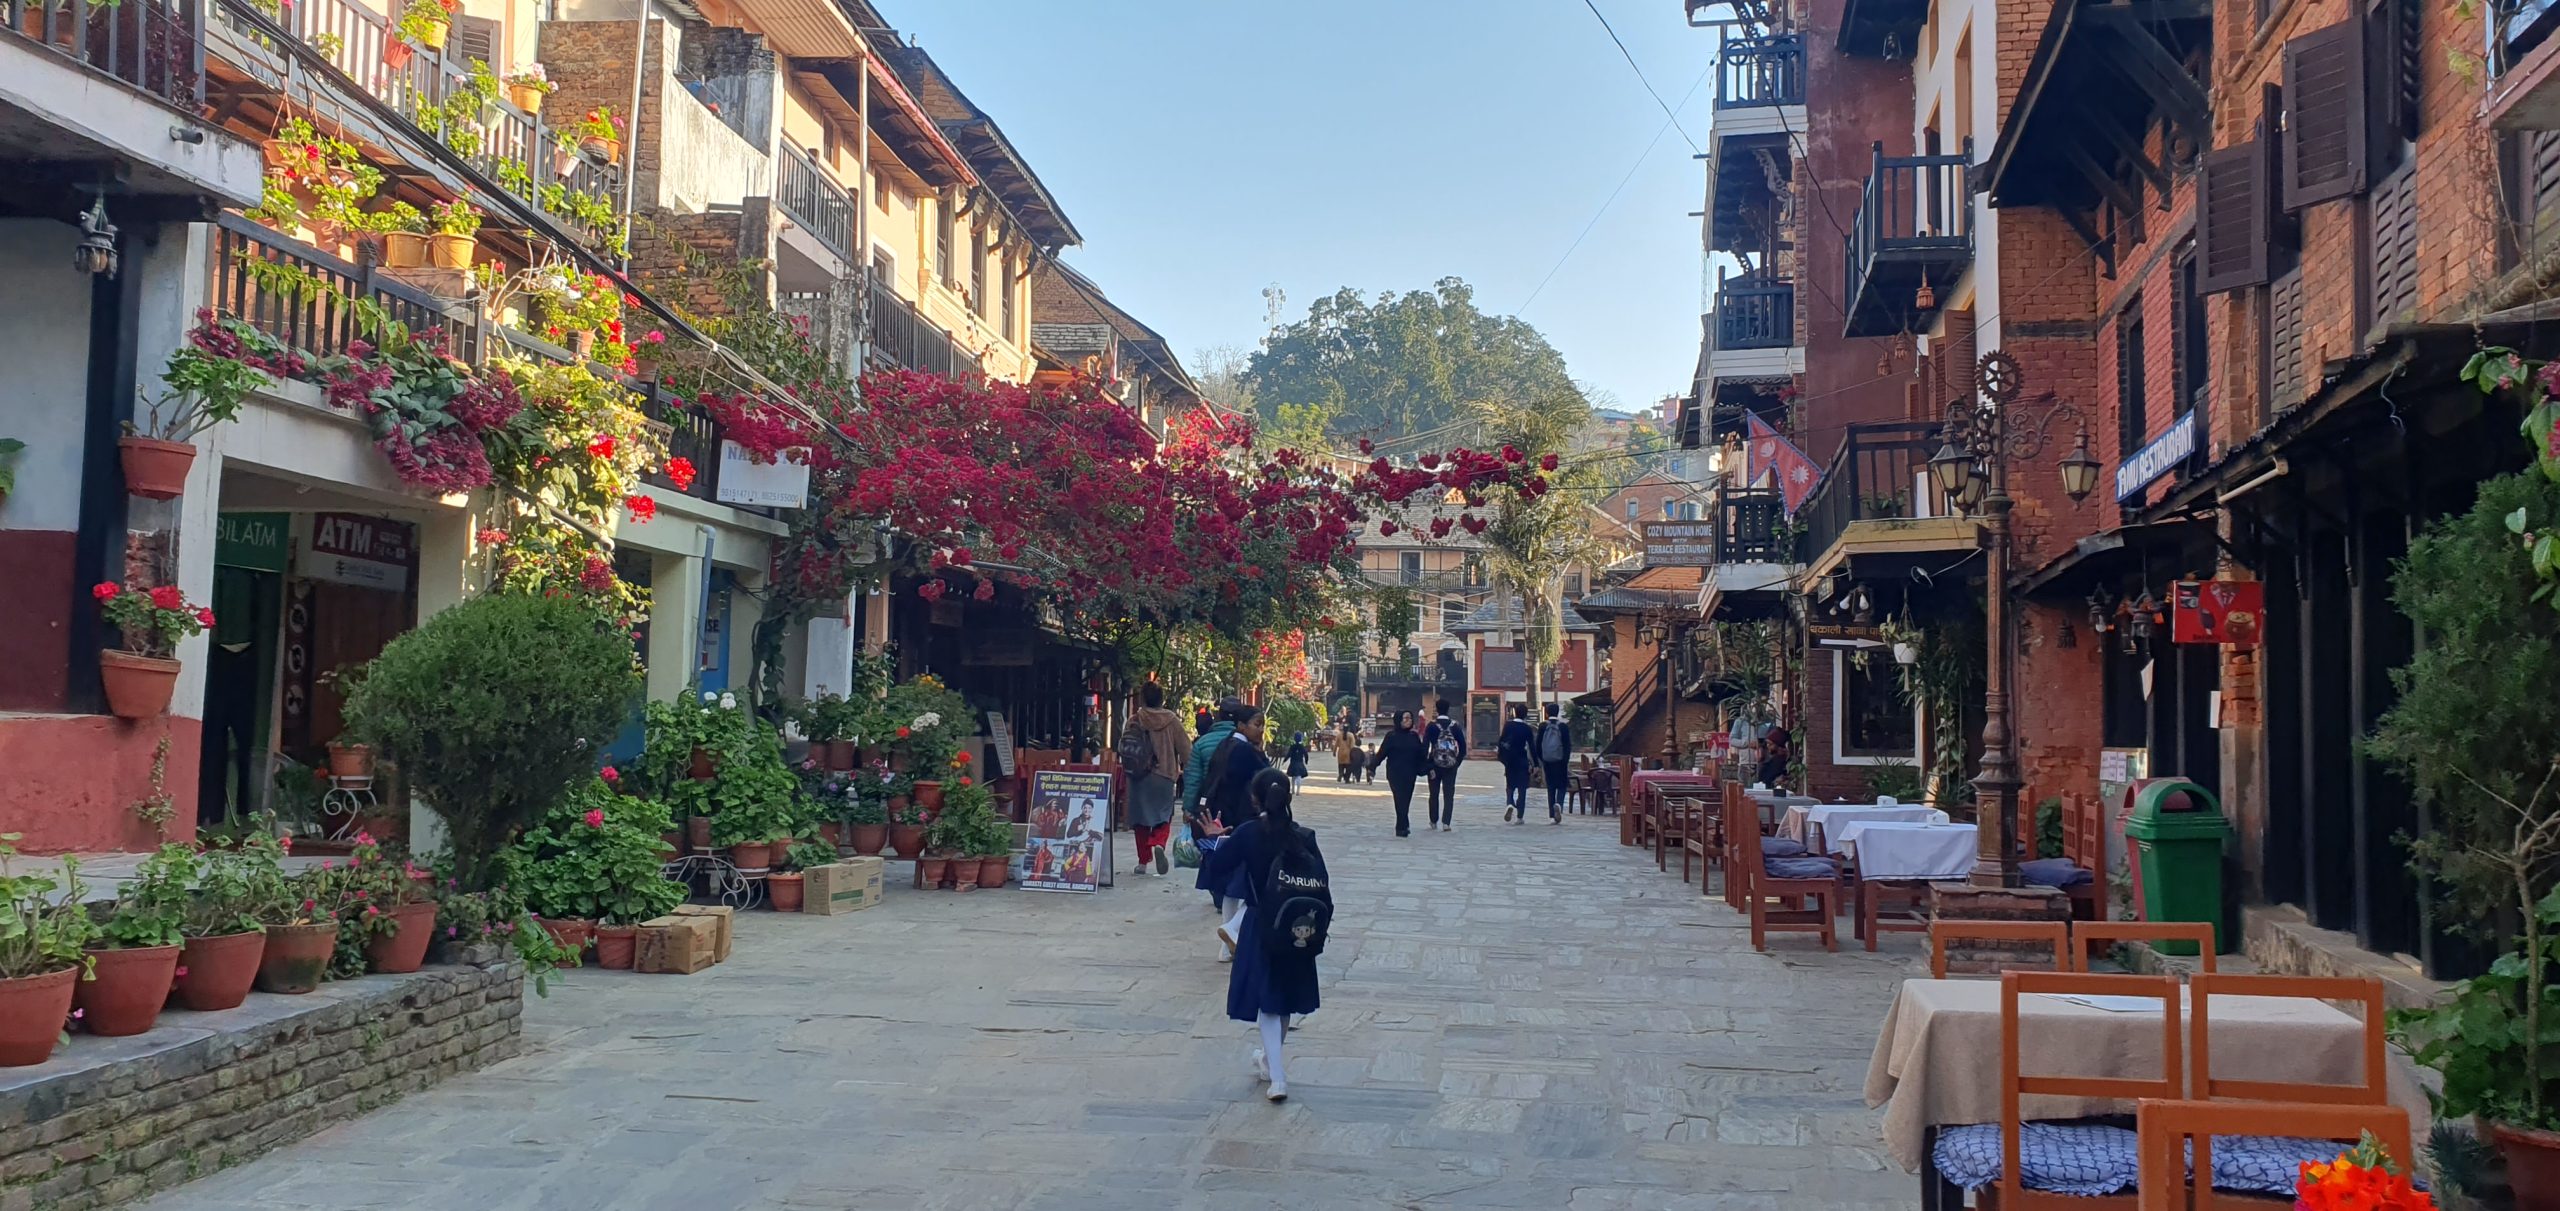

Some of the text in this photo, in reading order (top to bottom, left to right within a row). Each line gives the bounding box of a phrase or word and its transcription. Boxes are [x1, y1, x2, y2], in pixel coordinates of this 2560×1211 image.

[241, 521, 276, 548] ATM
[317, 516, 372, 554] ATM
[1647, 524, 1712, 537] COZY MOUNTAIN HOME
[1647, 544, 1712, 554] TERRACE RESTAURANT
